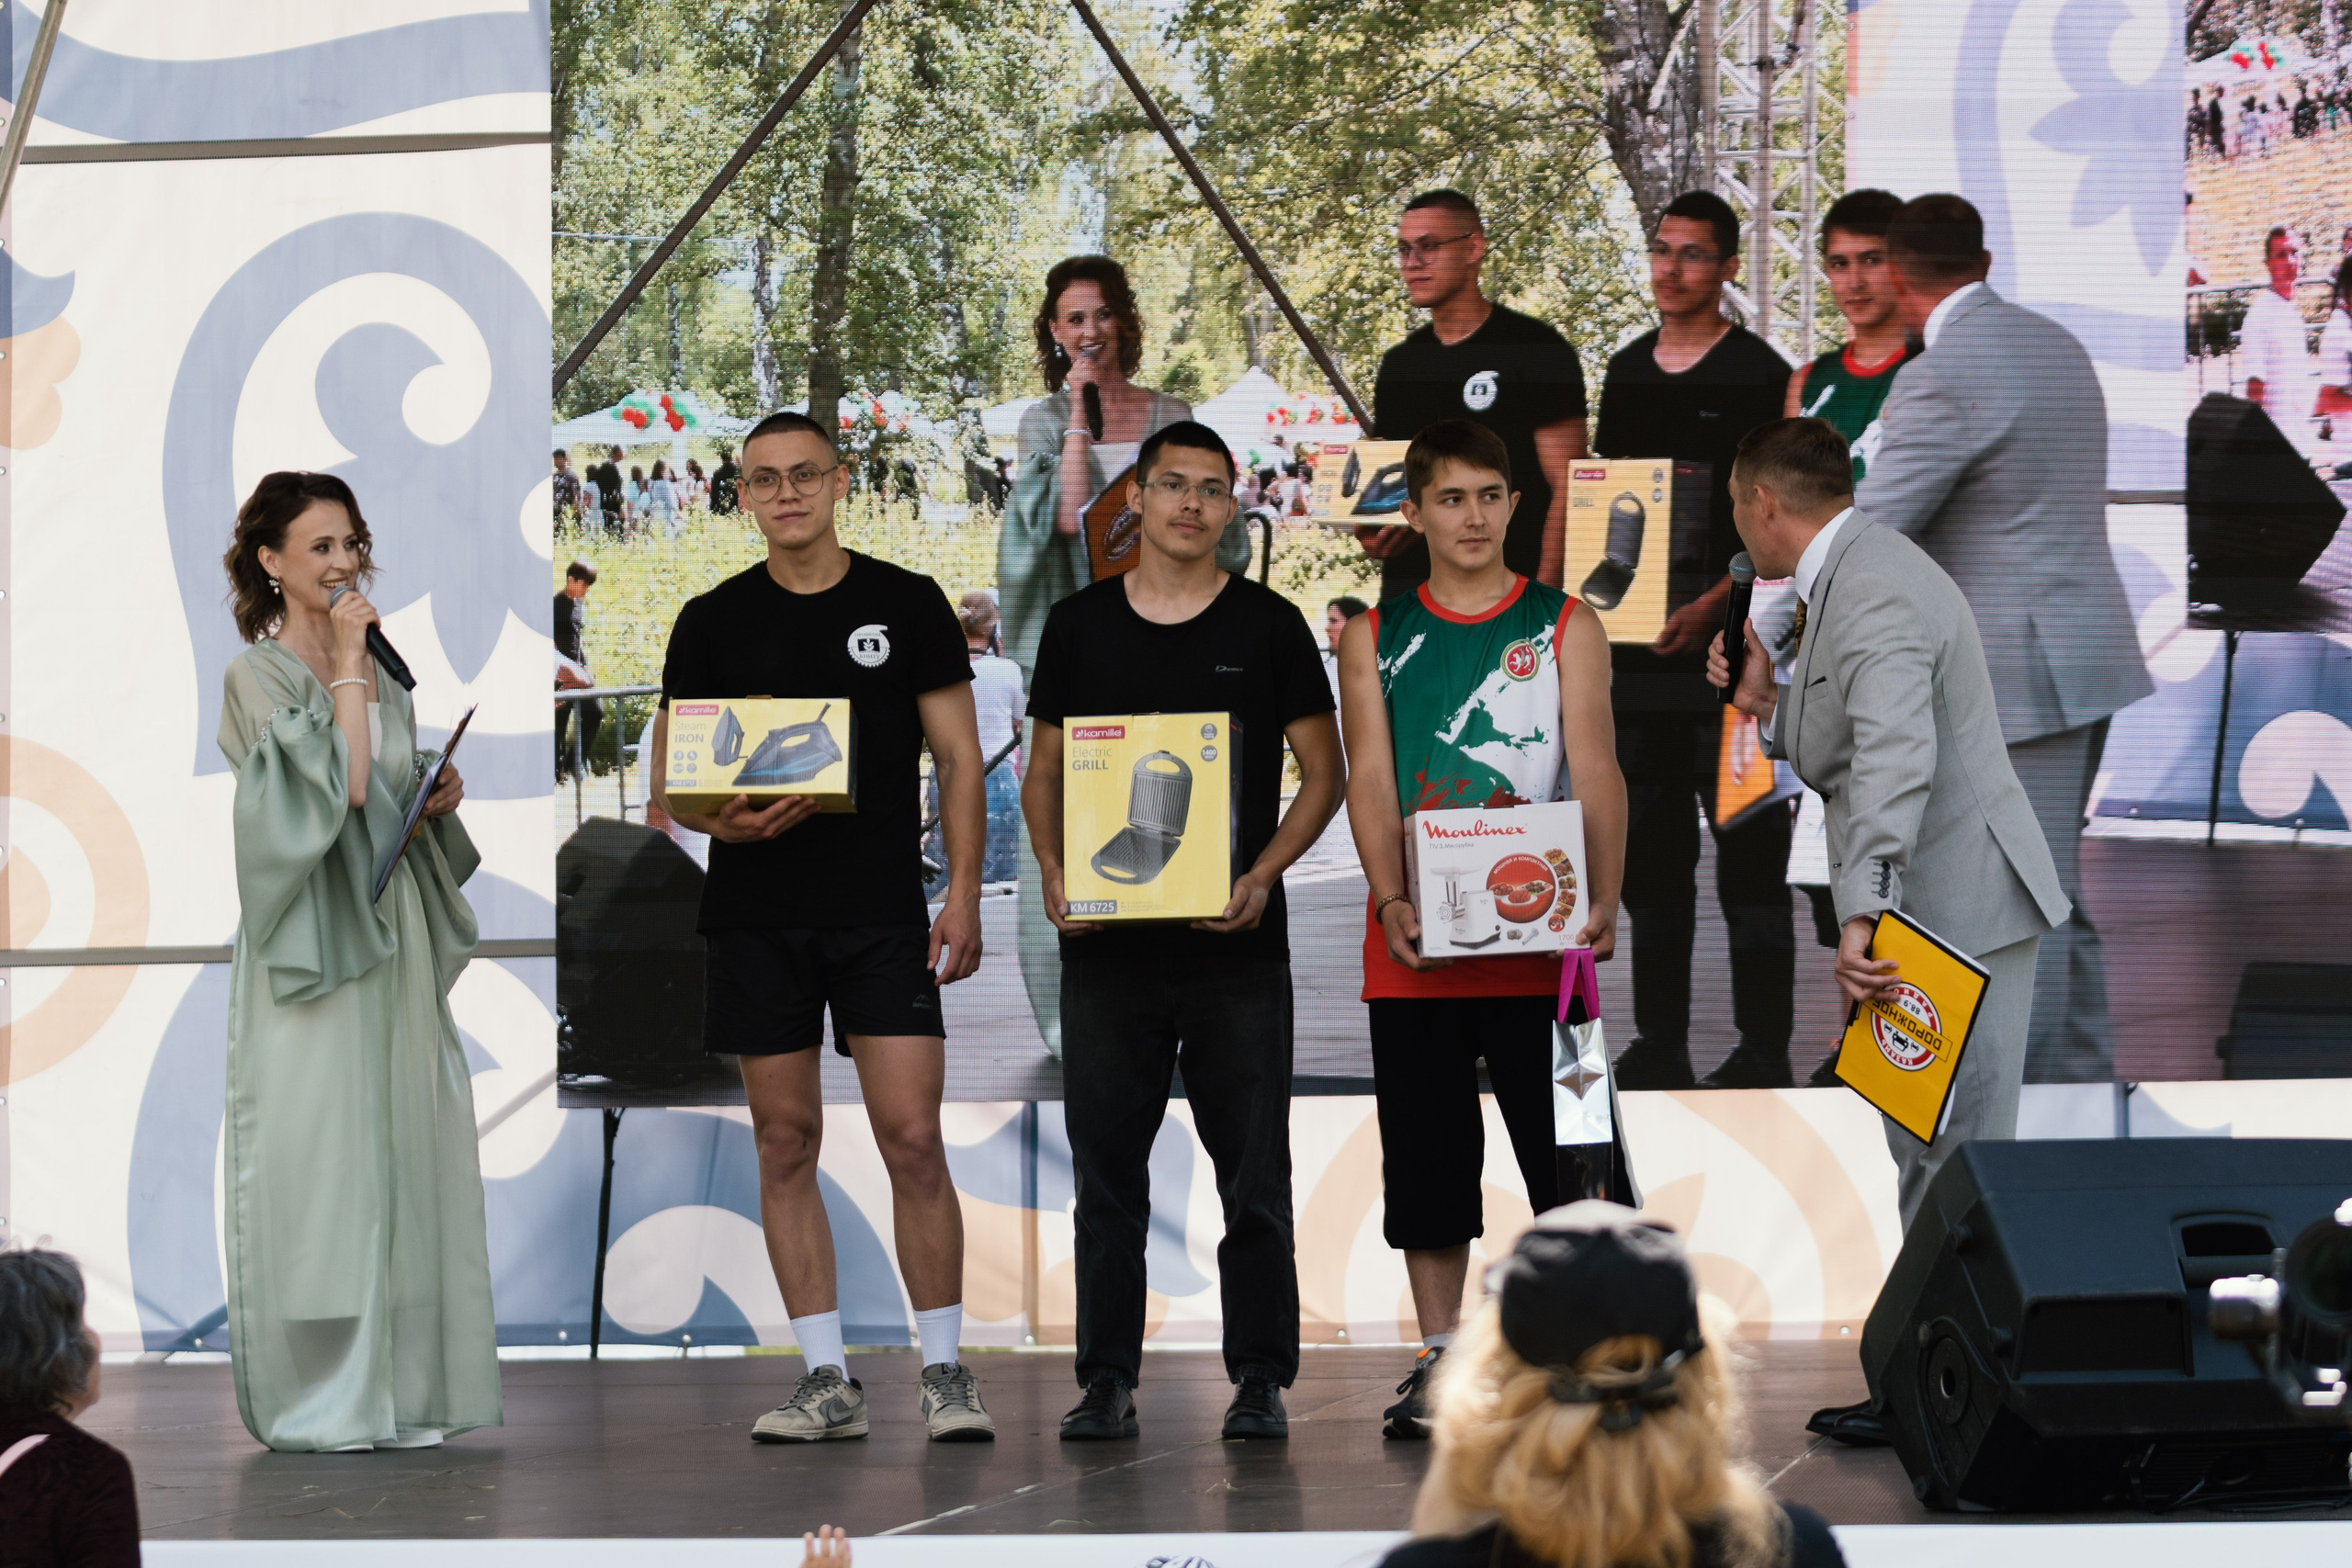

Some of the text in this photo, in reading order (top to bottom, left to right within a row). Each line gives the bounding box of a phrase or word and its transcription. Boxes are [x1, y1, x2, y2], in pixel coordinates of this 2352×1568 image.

[684, 705, 718, 715] kamille
[674, 720, 707, 731] Steam
[674, 734, 705, 743] IRON
[1083, 728, 1123, 738] kamille
[1072, 746, 1113, 758] Electric
[1072, 760, 1109, 771] GRILL
[1422, 818, 1528, 840] Moulinex
[1070, 903, 1087, 913] KM
[1090, 902, 1114, 912] 6725
[1903, 999, 1921, 1015] 88.9
[1881, 1038, 1914, 1066] КАЗАНЬ
